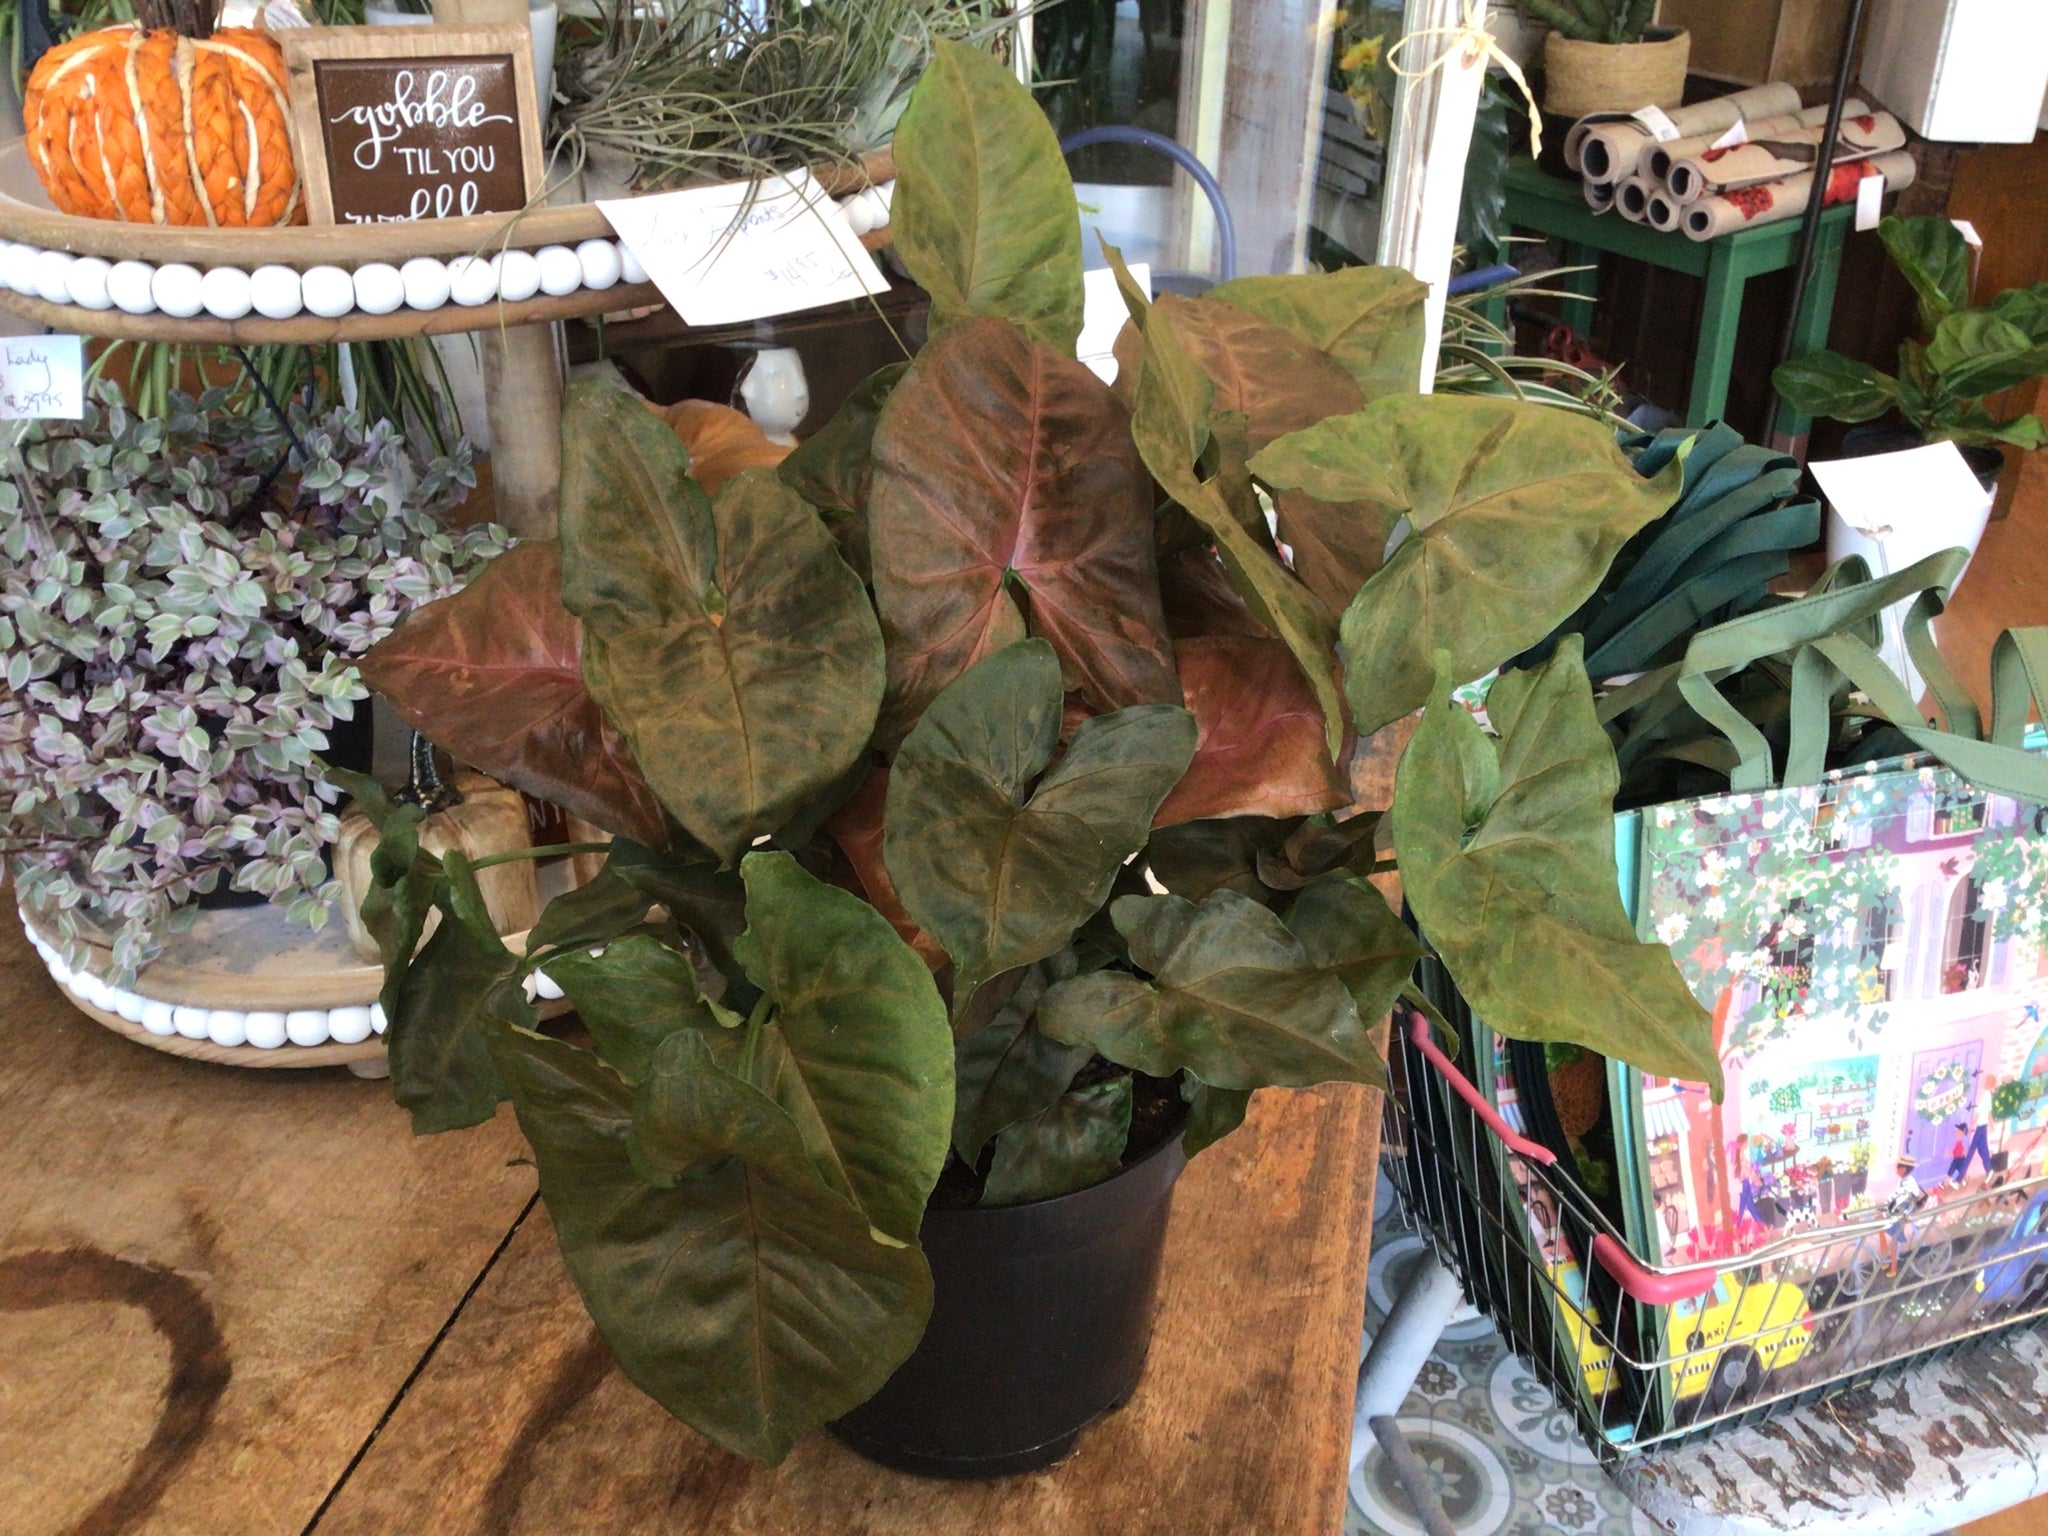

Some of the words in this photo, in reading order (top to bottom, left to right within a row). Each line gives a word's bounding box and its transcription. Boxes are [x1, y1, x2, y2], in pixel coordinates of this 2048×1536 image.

[331, 70, 513, 170] gobble
[393, 147, 440, 175] 'TIL
[443, 145, 495, 173] YOU
